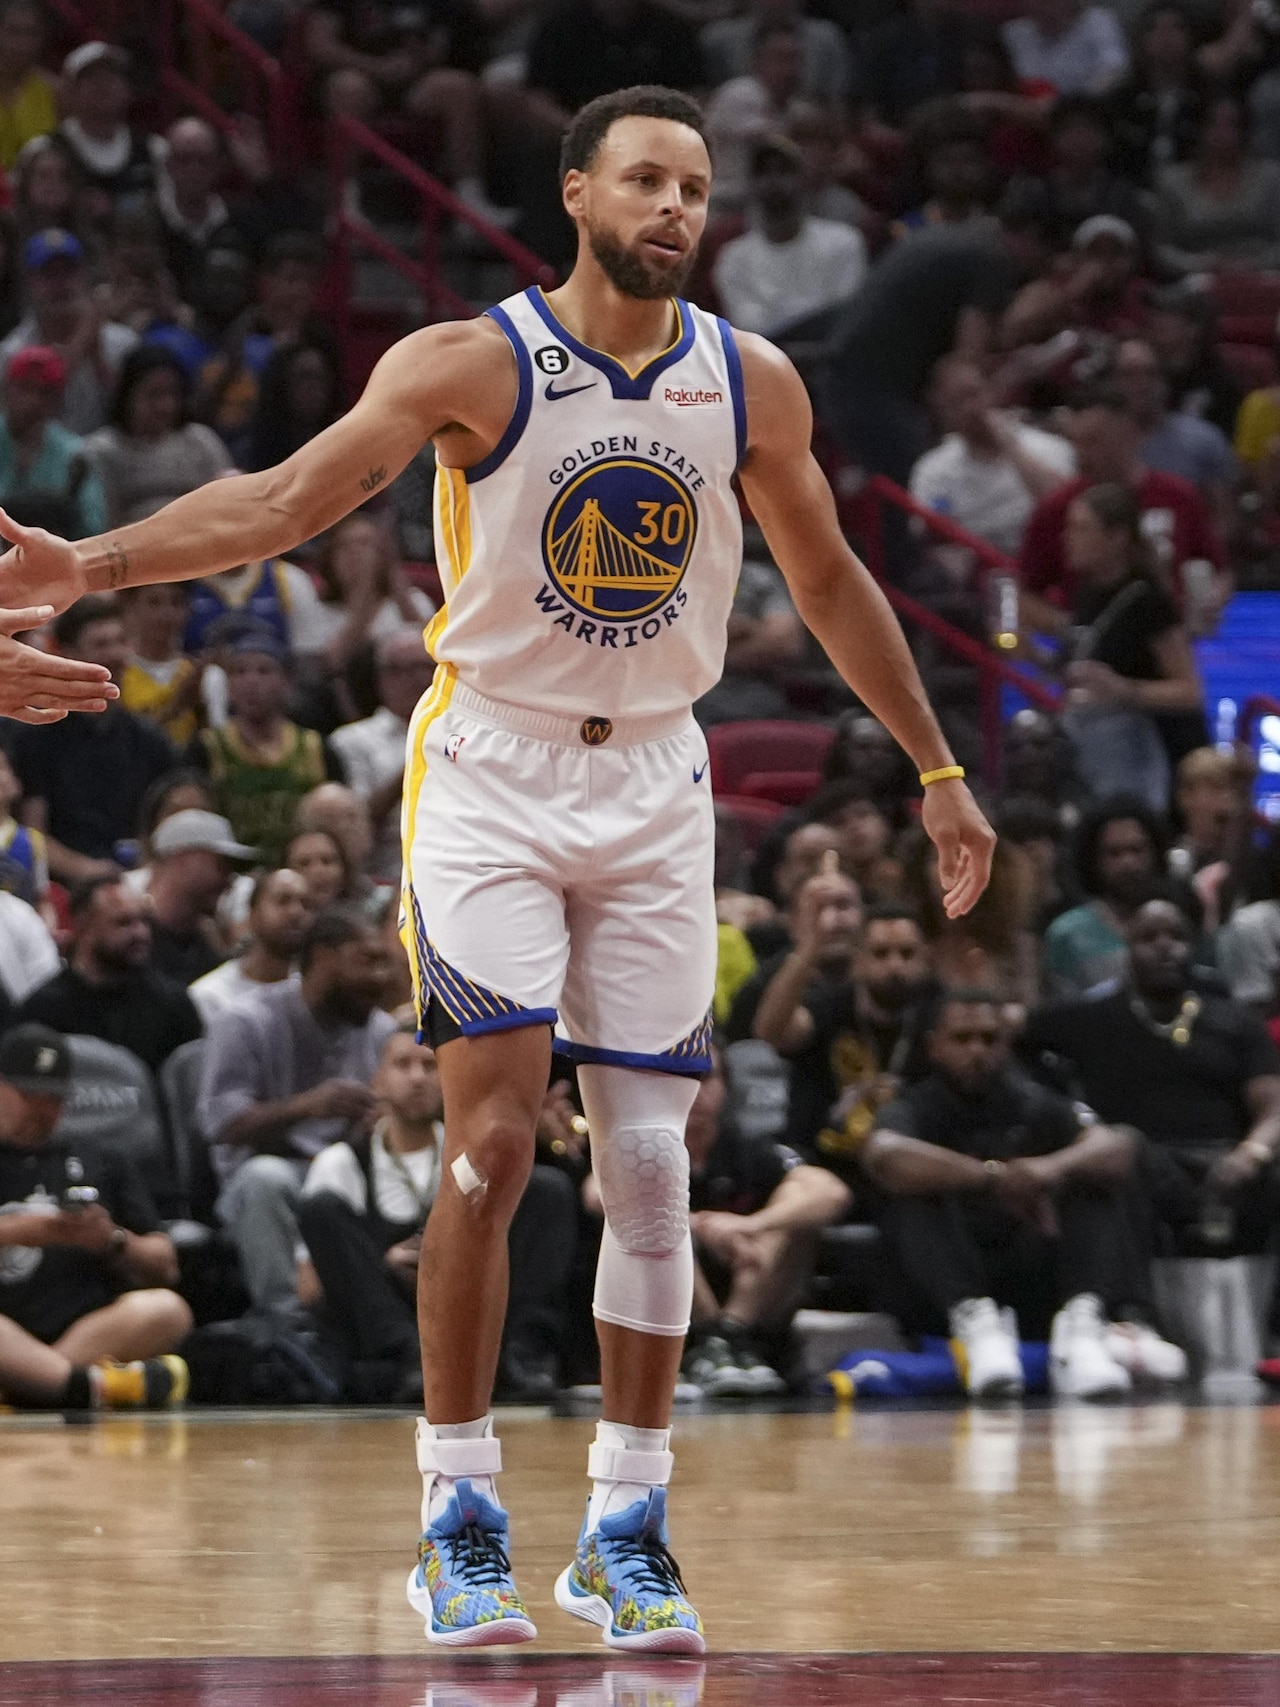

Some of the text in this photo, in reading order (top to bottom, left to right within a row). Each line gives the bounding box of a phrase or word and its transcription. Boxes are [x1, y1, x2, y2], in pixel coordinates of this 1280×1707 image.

[540, 349, 562, 372] 6
[665, 388, 722, 403] Rakuten
[549, 436, 706, 491] GOLDEN STATE
[633, 501, 686, 545] 30
[534, 583, 688, 648] WARRIORS
